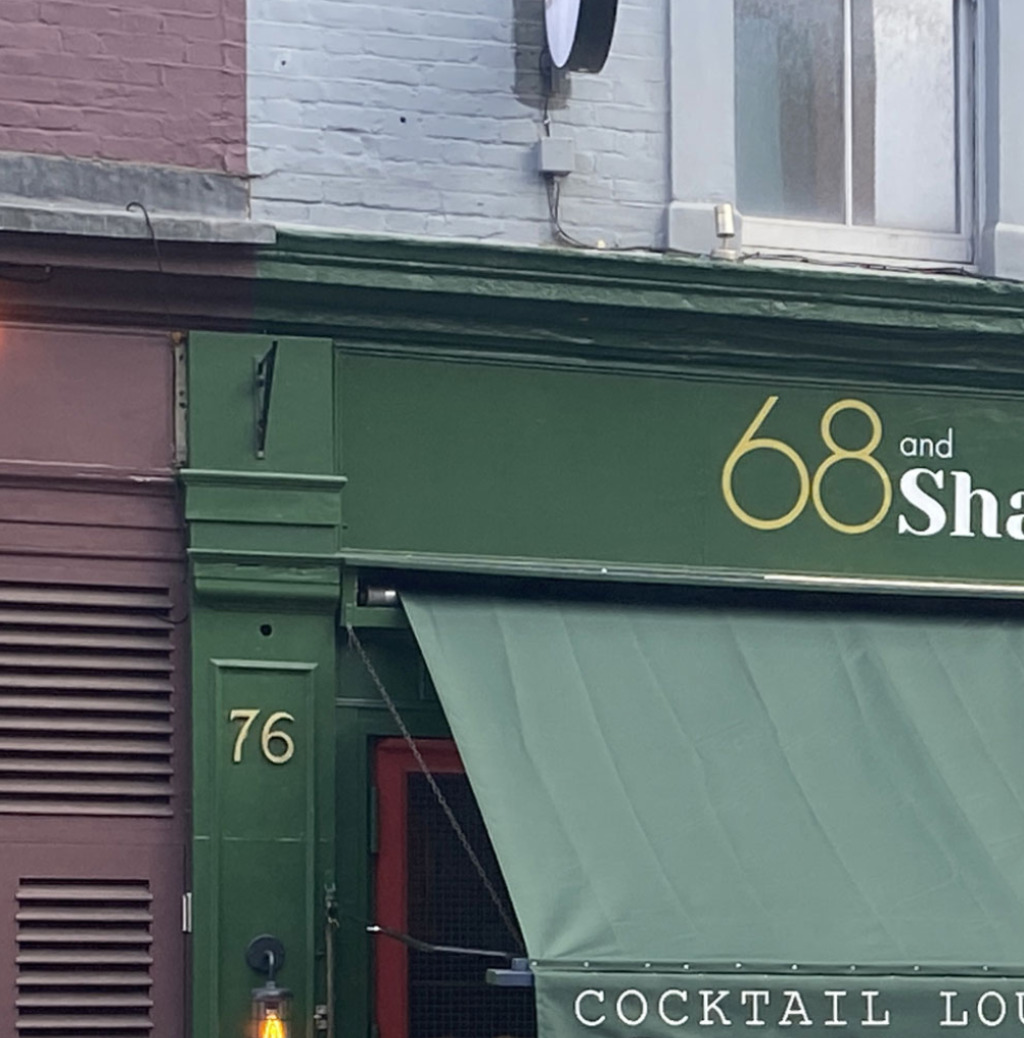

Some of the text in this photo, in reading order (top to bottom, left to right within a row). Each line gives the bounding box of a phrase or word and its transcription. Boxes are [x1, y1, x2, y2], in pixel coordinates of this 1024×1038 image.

[722, 395, 893, 535] 68
[900, 427, 954, 459] and
[229, 708, 296, 764] 76
[573, 989, 891, 1028] COCKTAIL
